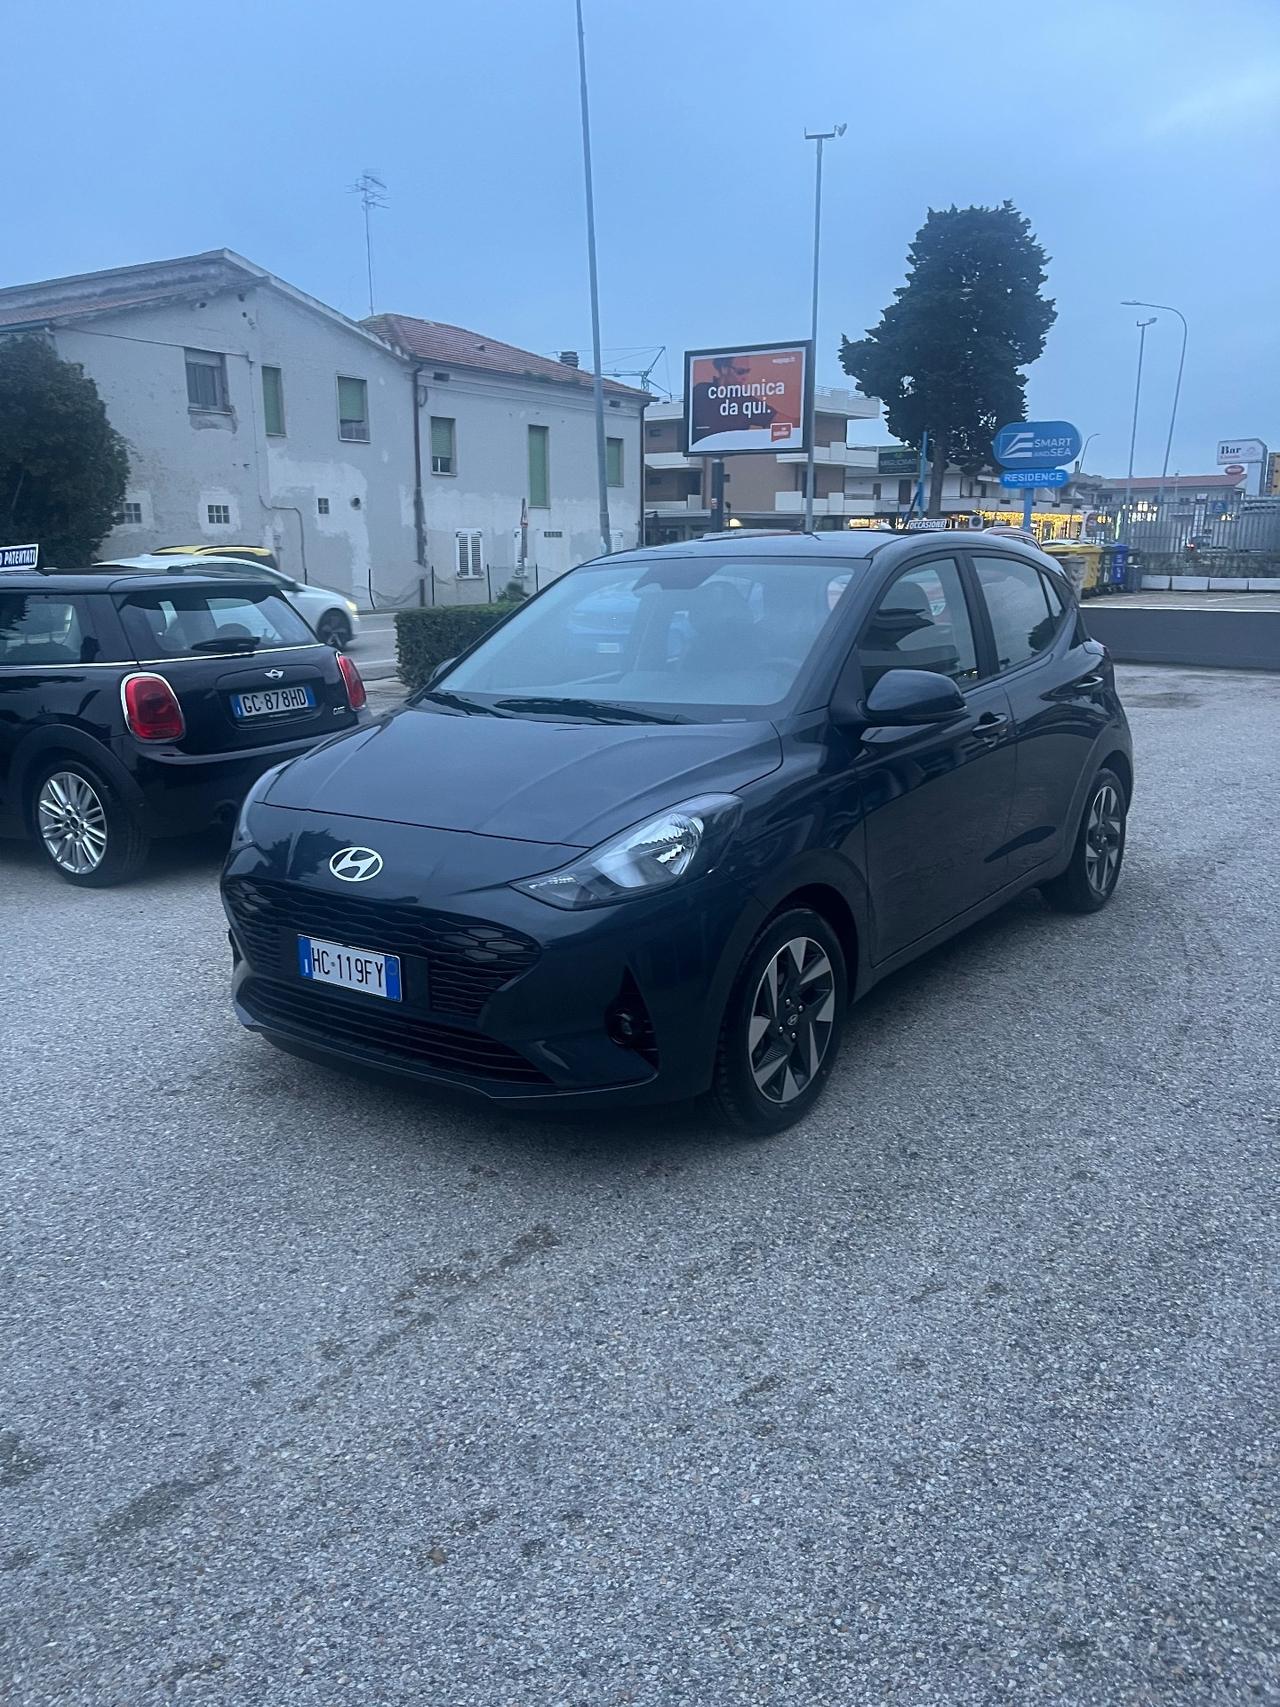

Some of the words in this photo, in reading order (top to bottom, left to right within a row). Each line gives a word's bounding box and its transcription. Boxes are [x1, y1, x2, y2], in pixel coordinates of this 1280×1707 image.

[708, 378, 785, 399] comunica
[719, 399, 738, 416] da
[742, 396, 771, 418] qui.
[1034, 437, 1072, 448] SMART
[1221, 445, 1242, 454] Bar
[1003, 472, 1064, 482] RESIDENCE
[4, 549, 36, 565] PATENTATI
